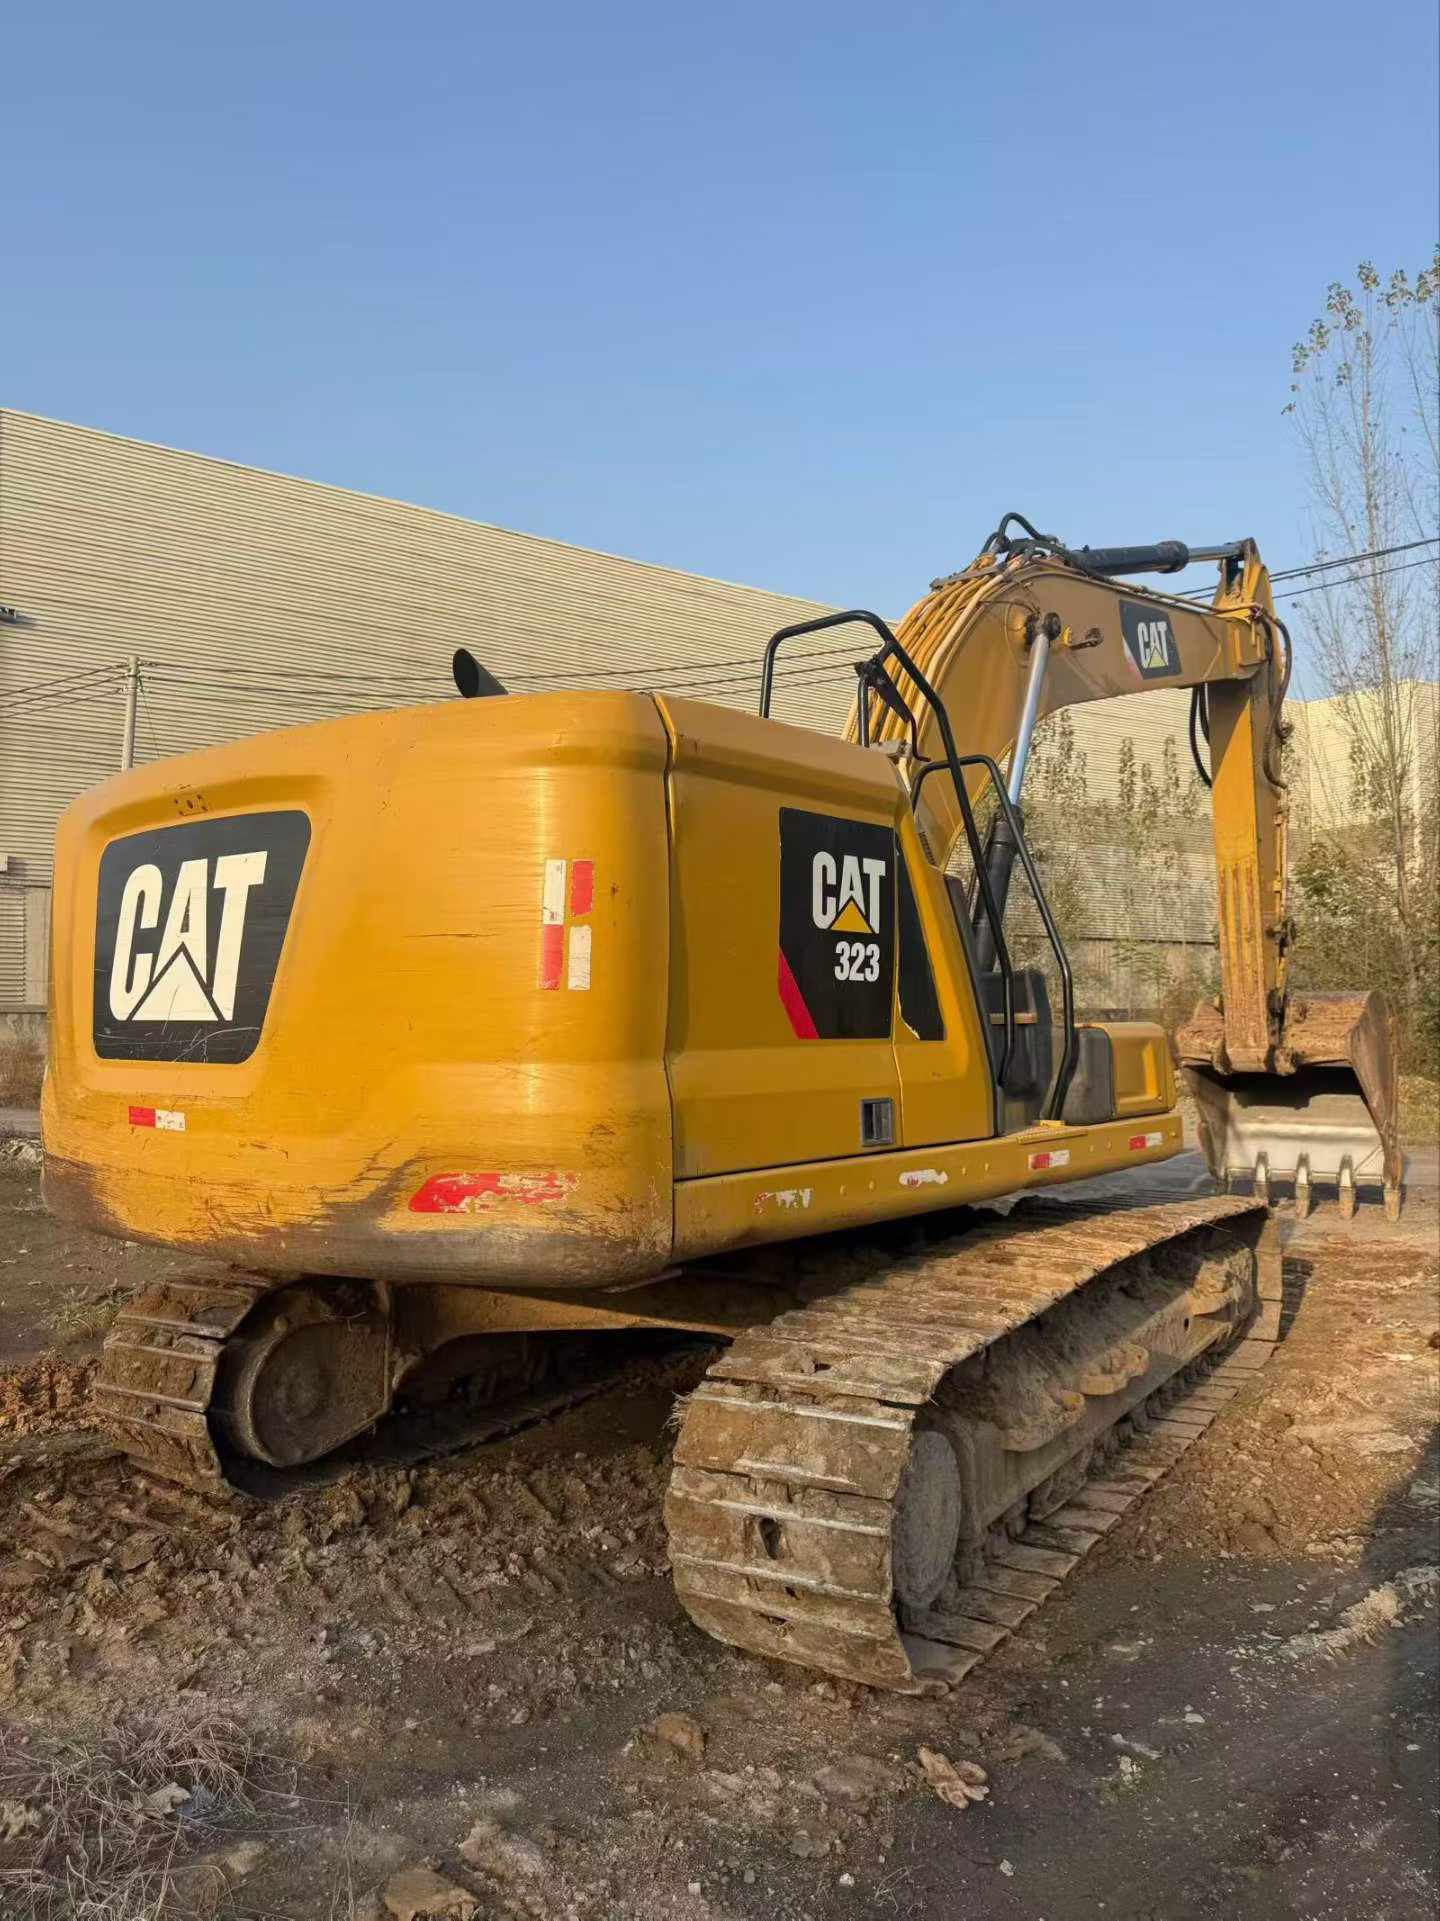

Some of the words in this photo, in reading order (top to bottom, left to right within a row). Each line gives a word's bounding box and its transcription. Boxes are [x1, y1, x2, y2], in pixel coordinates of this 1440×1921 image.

[1138, 621, 1168, 669] CAT
[812, 851, 886, 934] CAT
[110, 851, 268, 1021] CAT
[834, 941, 880, 982] 323
